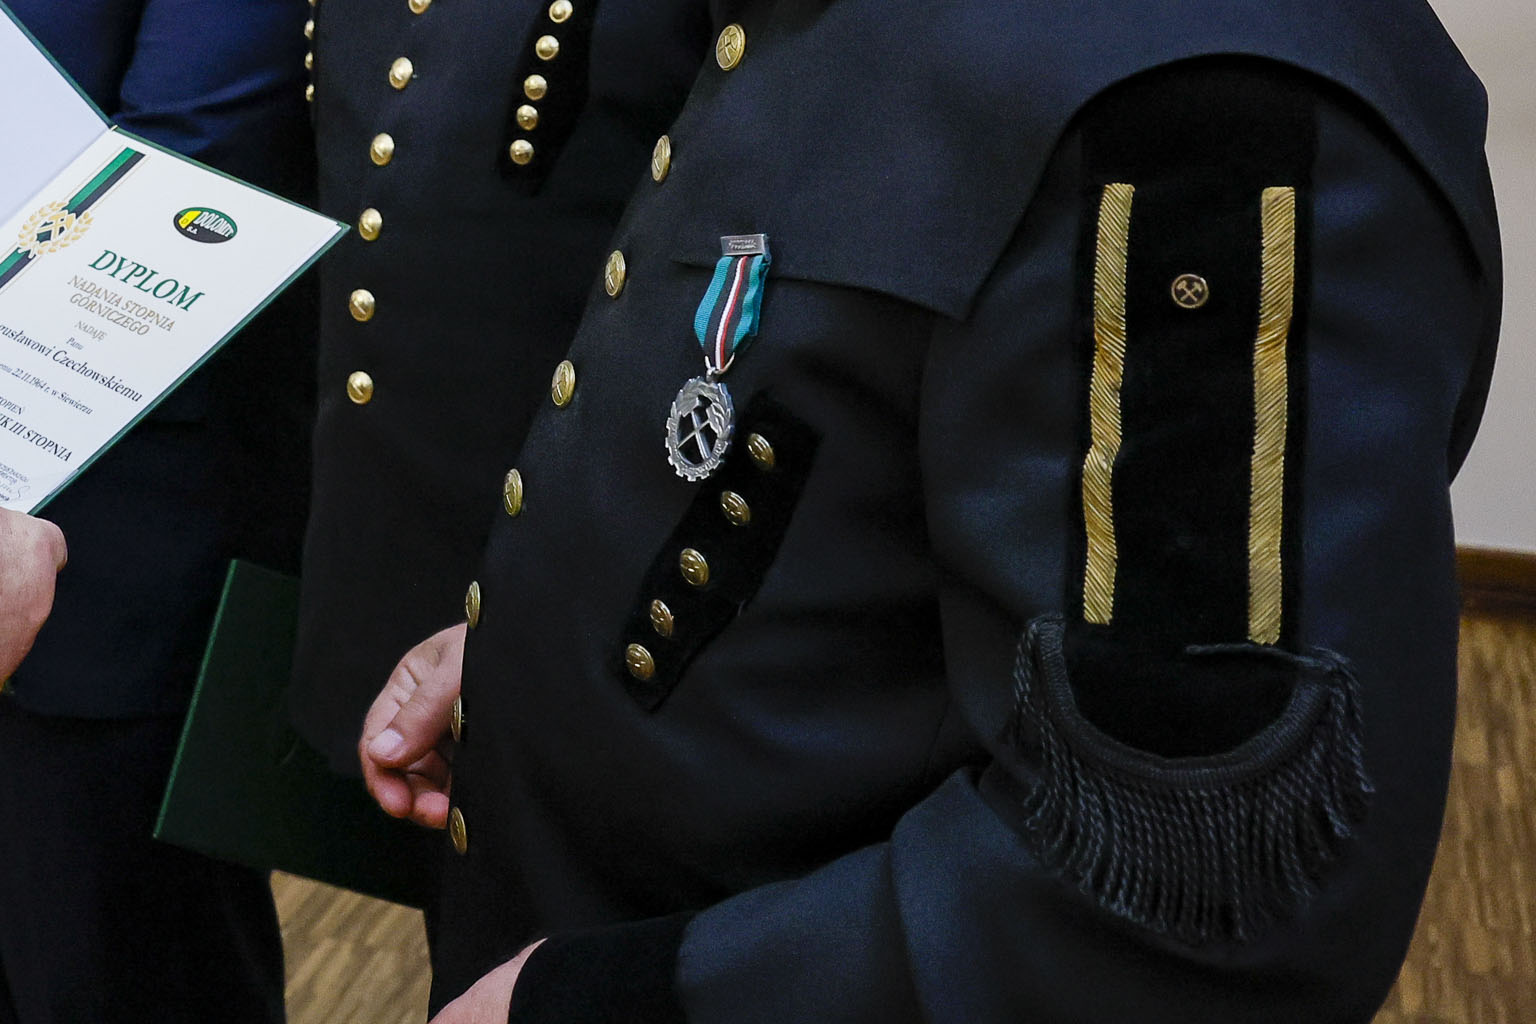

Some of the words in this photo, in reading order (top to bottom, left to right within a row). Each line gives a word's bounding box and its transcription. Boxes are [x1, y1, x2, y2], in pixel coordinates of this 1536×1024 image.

[67, 275, 122, 308] NADANIA
[121, 299, 176, 332] STOPNIA
[88, 249, 205, 312] DYPLOM
[69, 290, 150, 336] GÓRNICZEGO
[66, 336, 84, 351] Panu
[11, 367, 47, 391] 22.11.1964
[58, 391, 94, 416] Siewierzu
[52, 350, 143, 402] Czechowskiemu
[13, 422, 26, 438] III
[22, 429, 73, 462] STOPNIA
